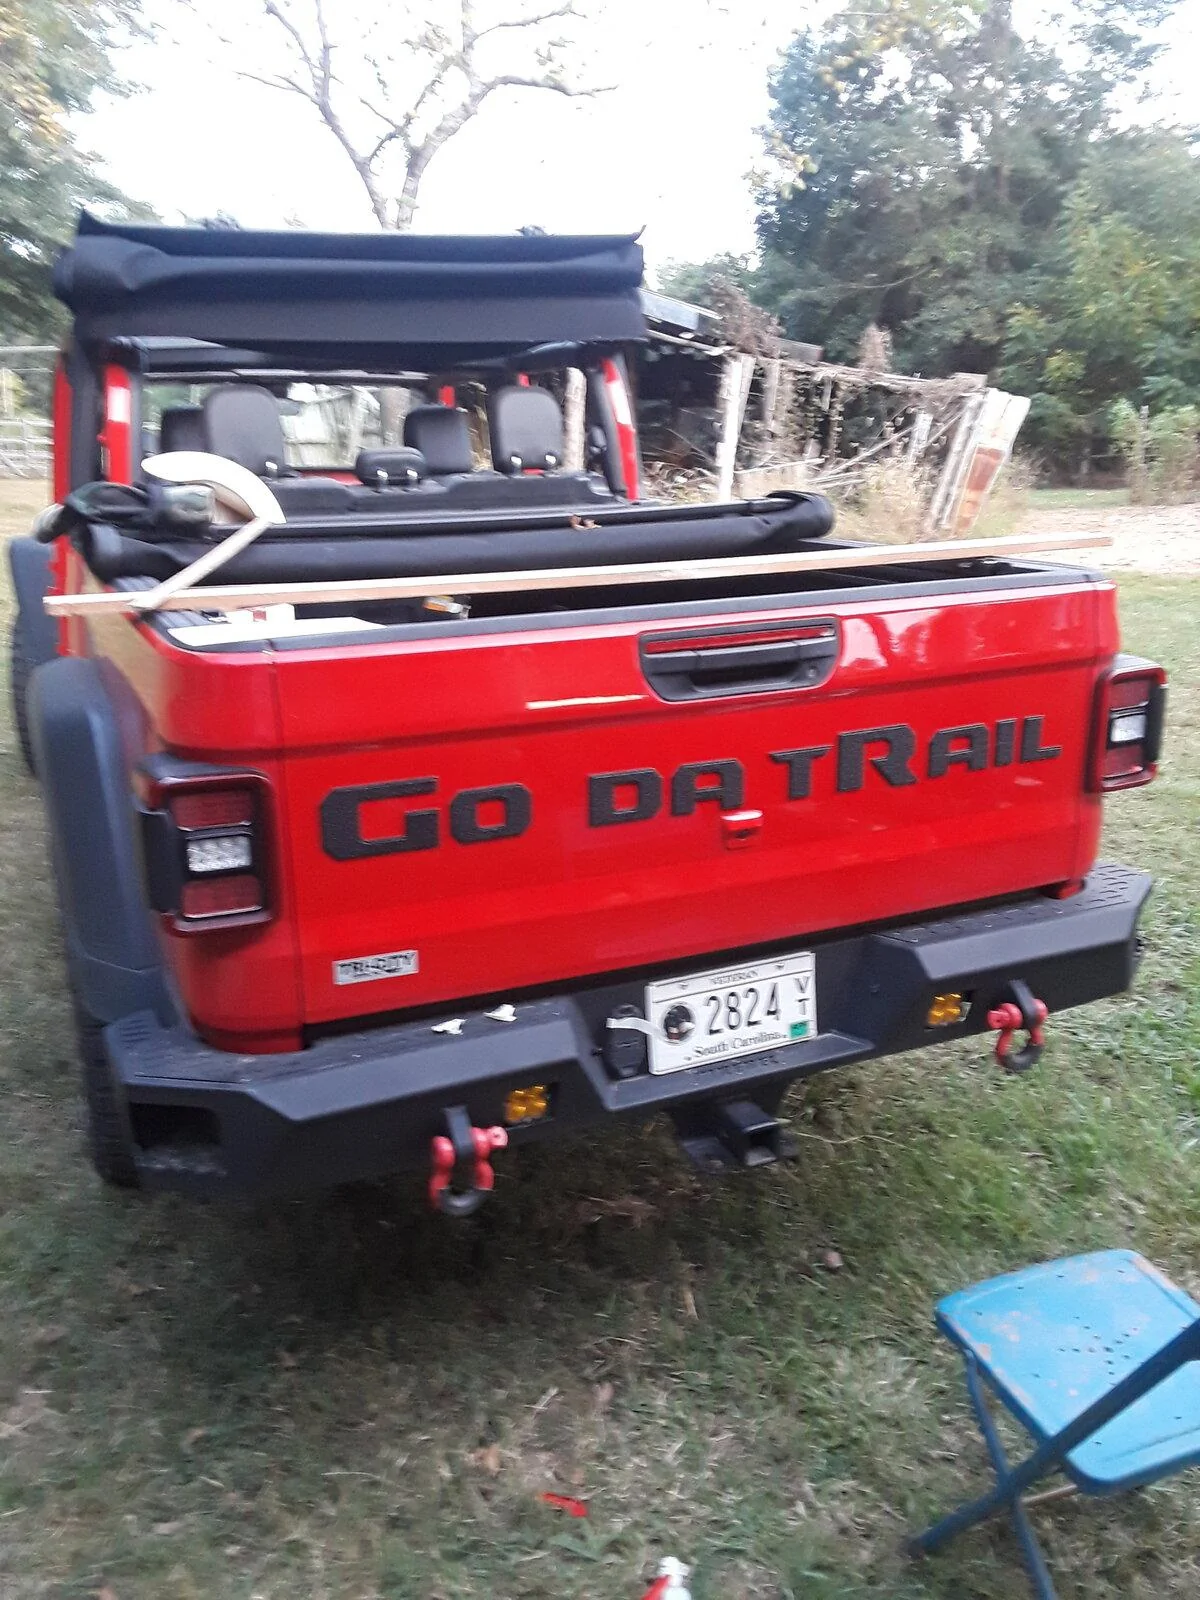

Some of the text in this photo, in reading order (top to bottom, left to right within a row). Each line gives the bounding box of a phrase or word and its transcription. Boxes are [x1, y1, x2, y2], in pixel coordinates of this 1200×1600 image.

[588, 758, 744, 828] DA
[768, 715, 1062, 800] TRAIL
[702, 982, 780, 1035] 2824
[694, 1031, 782, 1056] South Carolina
